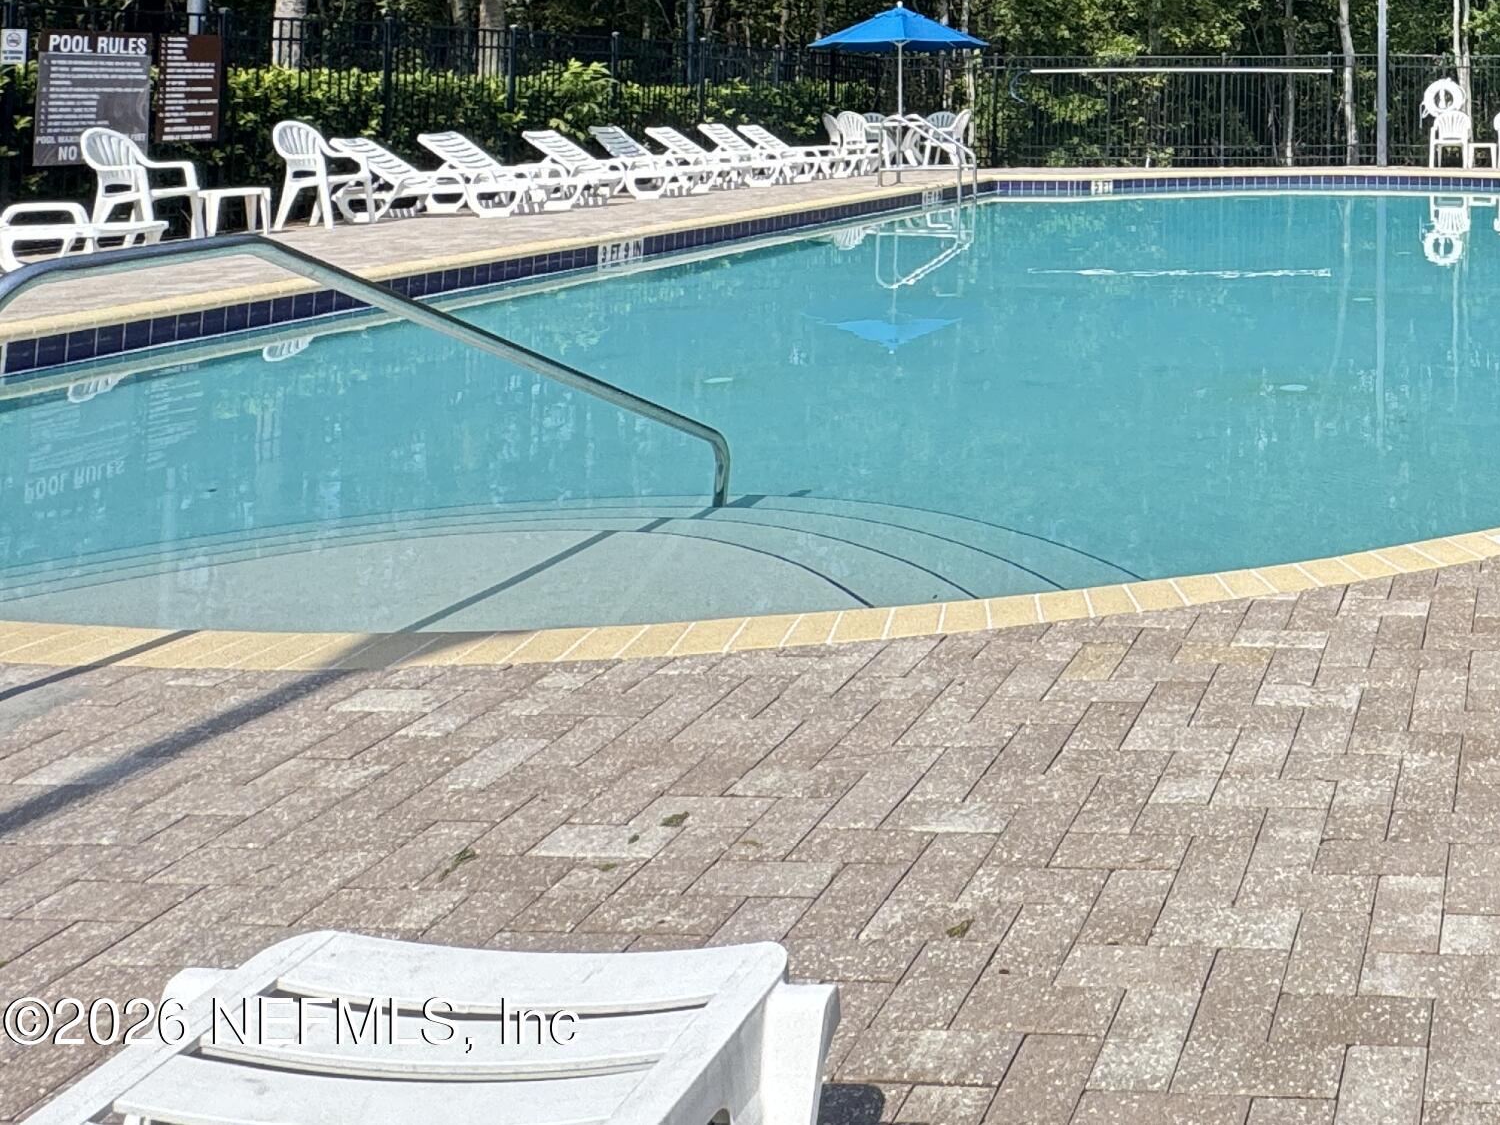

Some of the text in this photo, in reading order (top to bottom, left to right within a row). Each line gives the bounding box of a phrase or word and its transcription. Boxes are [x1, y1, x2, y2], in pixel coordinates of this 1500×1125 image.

[48, 34, 93, 53] POOL
[97, 36, 147, 55] RULES
[57, 146, 78, 161] NO
[611, 243, 621, 261] FT
